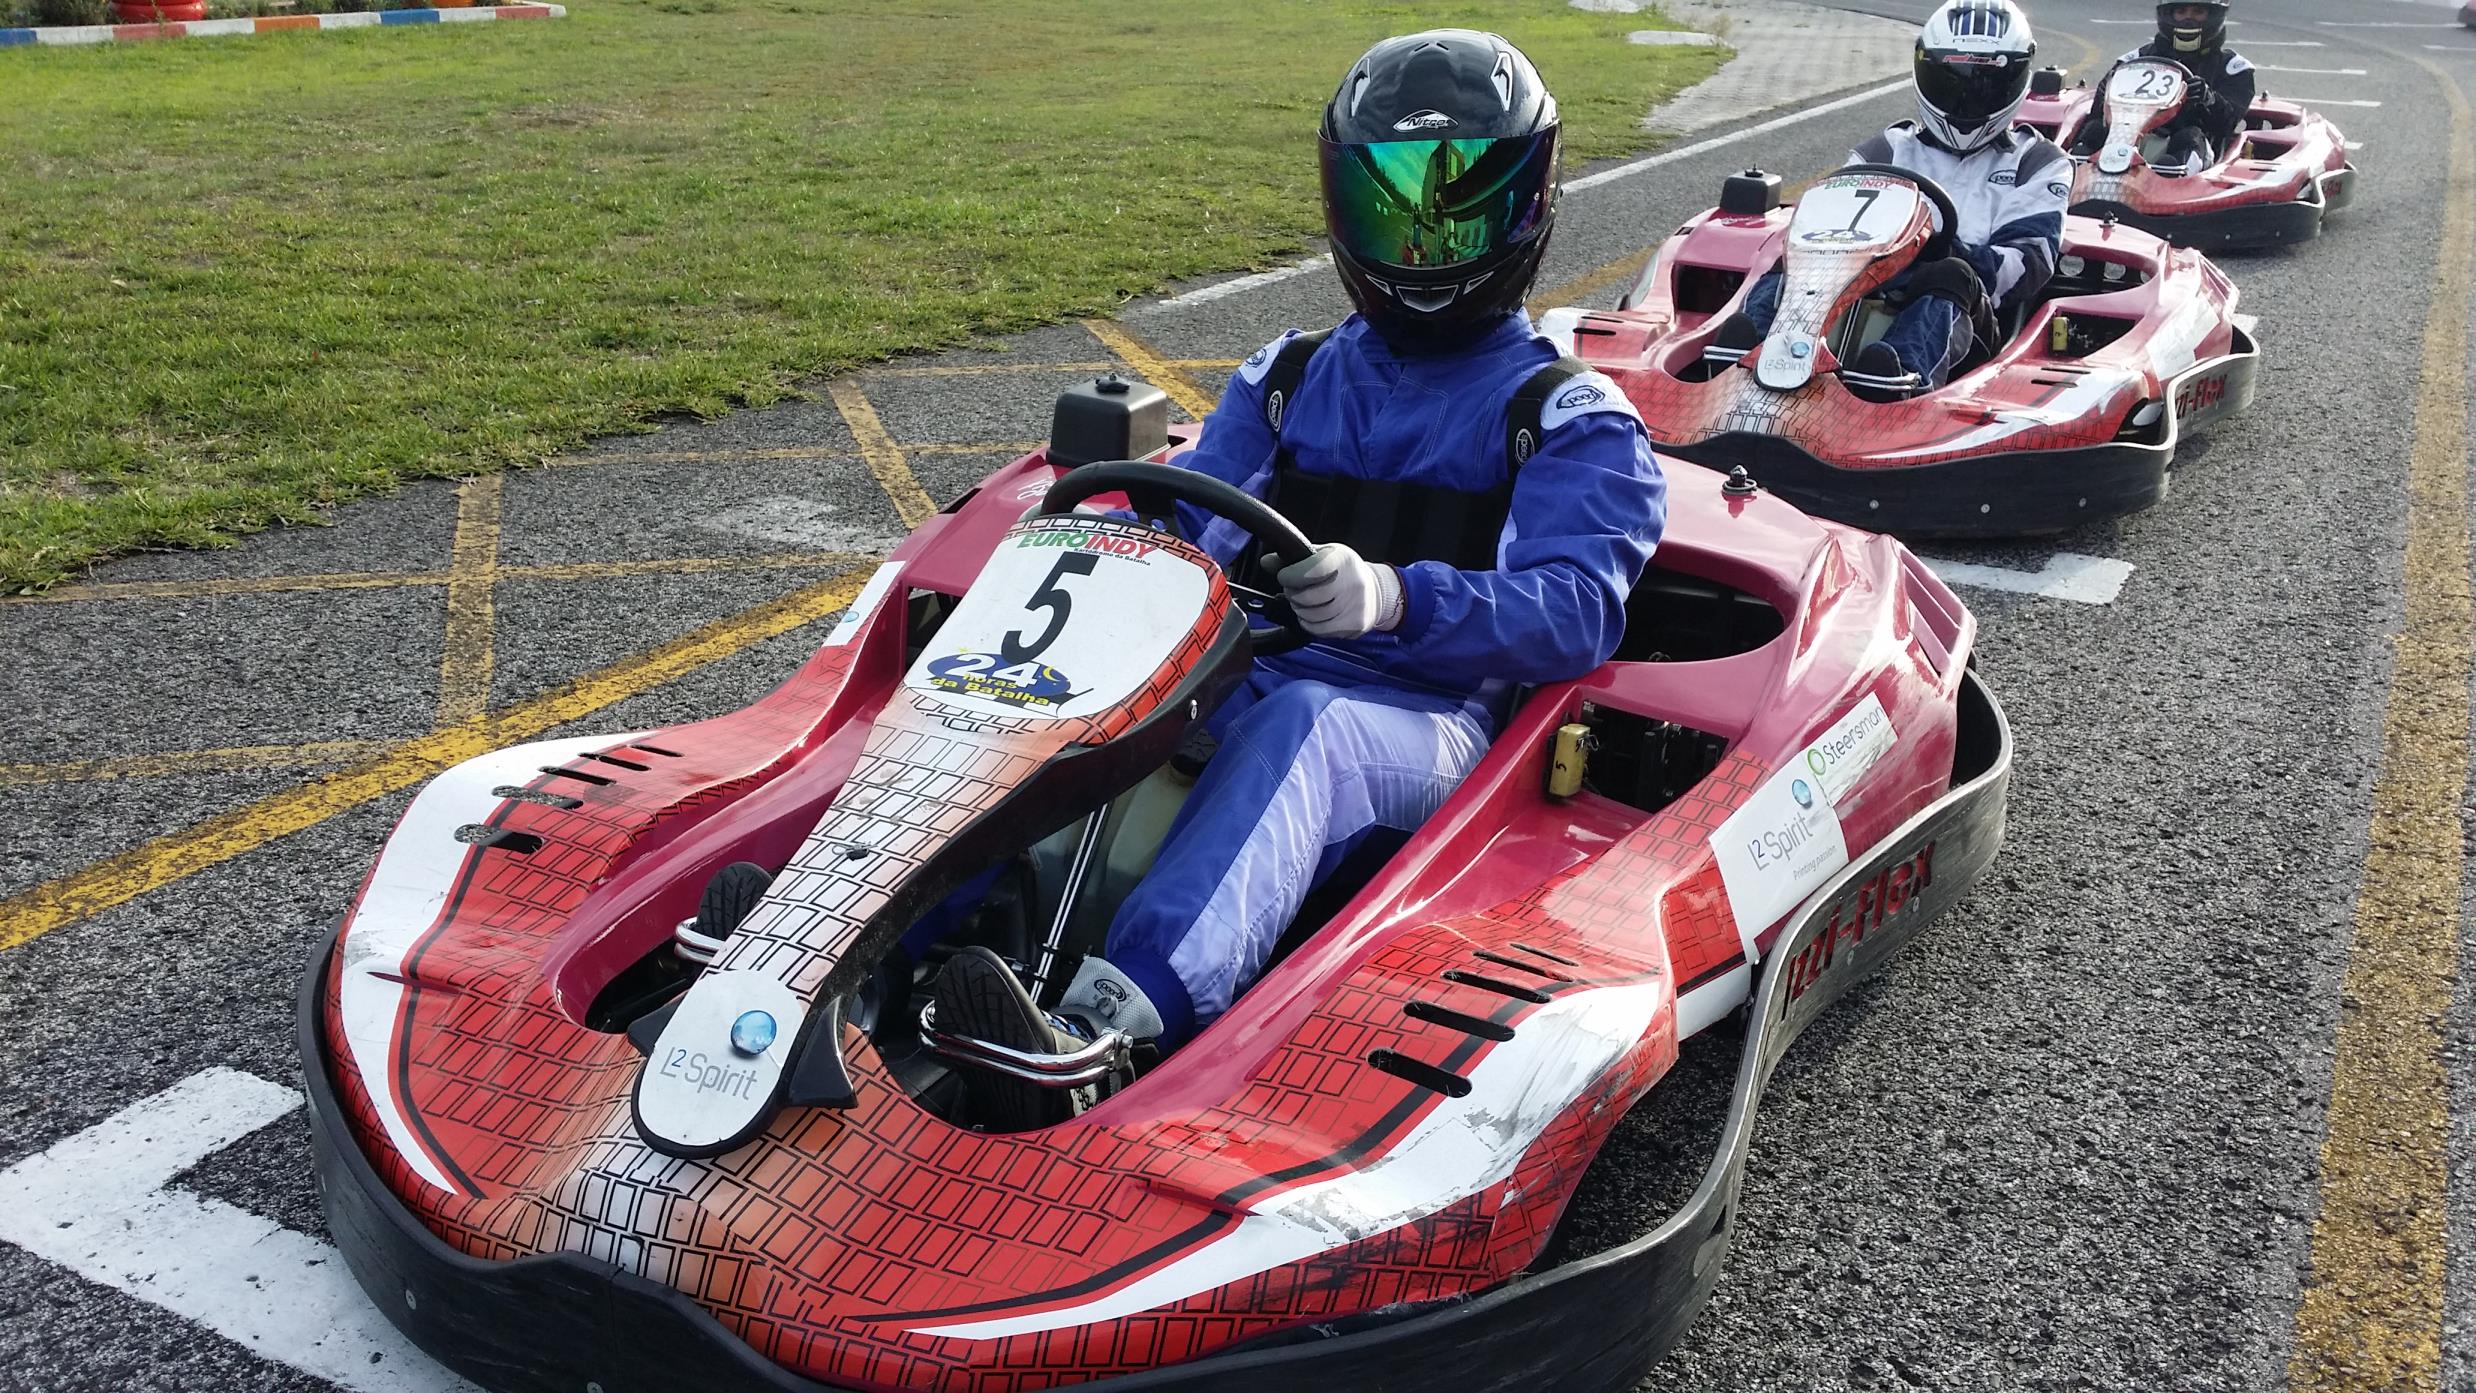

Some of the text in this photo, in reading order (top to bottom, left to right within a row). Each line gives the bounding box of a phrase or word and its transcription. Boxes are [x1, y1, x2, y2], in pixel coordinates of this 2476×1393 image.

[2135, 70, 2174, 97] 23
[1407, 116, 1446, 128] Nitro
[1848, 189, 1881, 231] 7
[1017, 532, 1158, 558] EUROINDY
[1125, 555, 1151, 566] Batalha
[1000, 551, 1100, 665] 5
[944, 653, 1042, 689] 24
[963, 673, 1019, 689] horas
[931, 677, 1051, 706] da Batalha
[1822, 706, 1887, 765] Steersman
